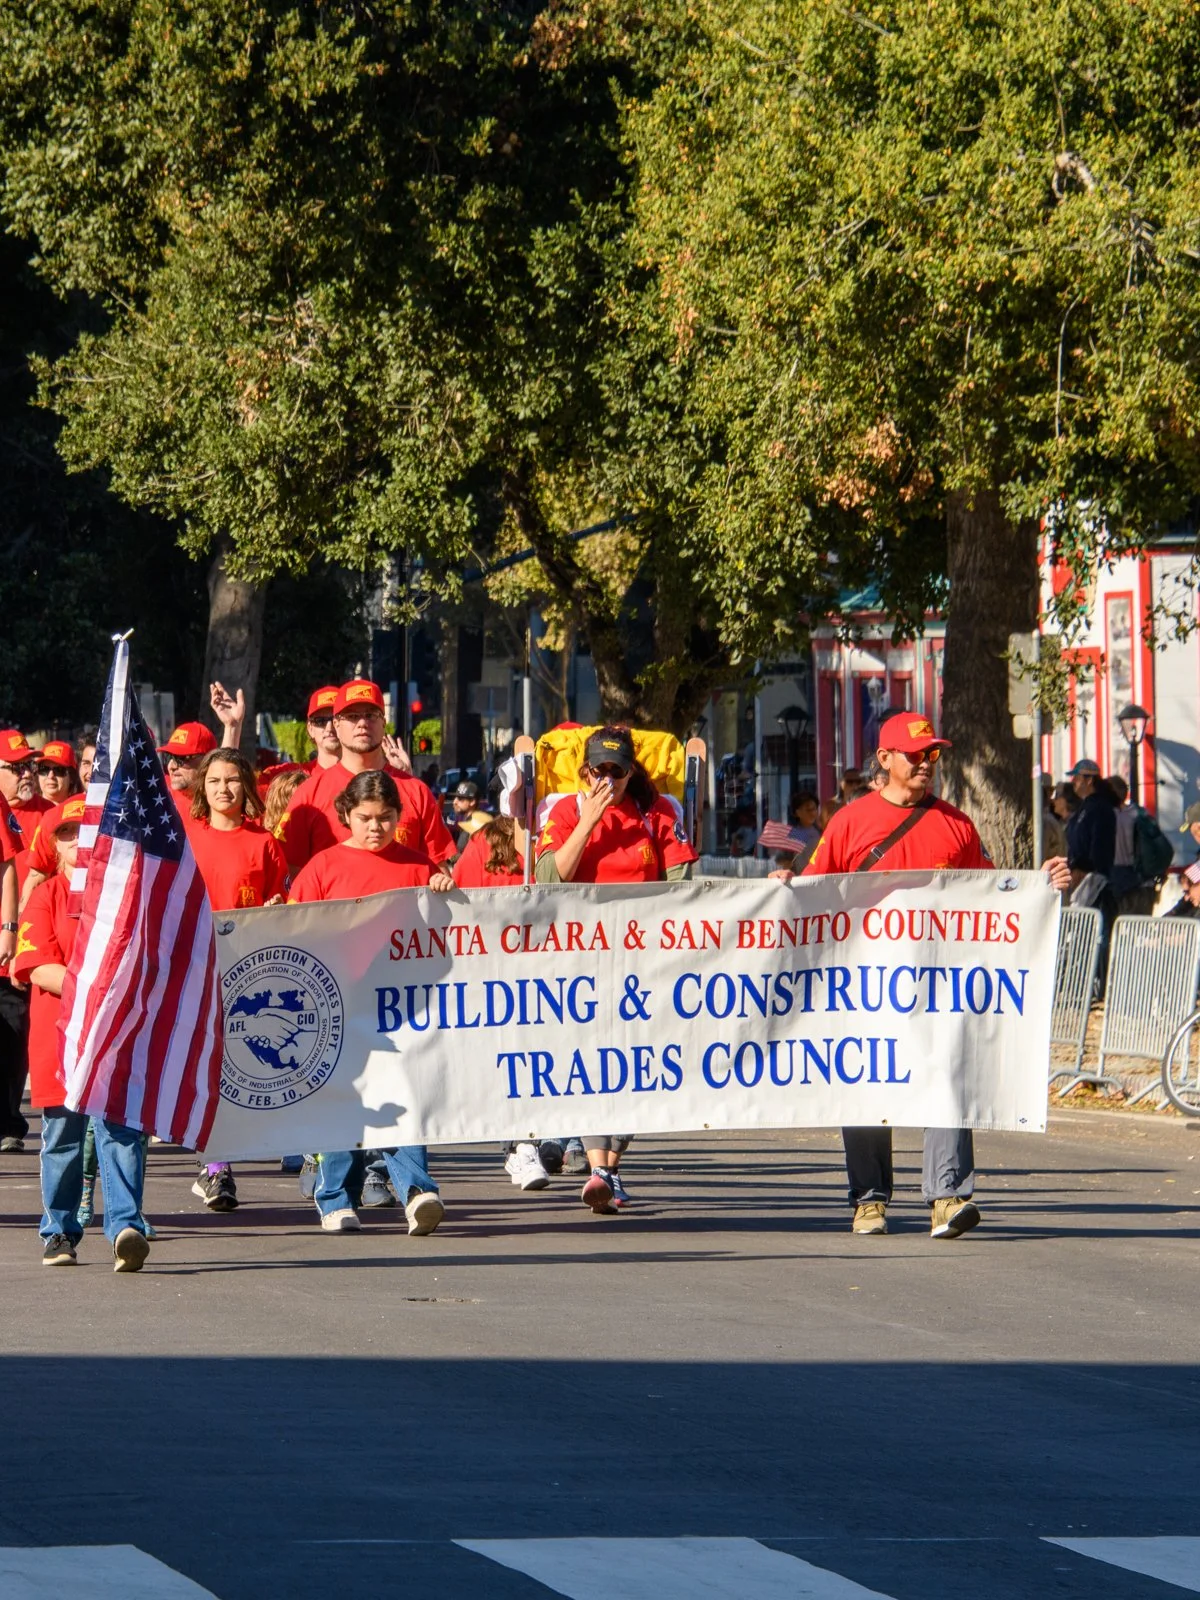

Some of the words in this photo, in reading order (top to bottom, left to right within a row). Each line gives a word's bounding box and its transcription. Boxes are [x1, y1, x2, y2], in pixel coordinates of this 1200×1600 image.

[388, 924, 489, 961] SANTA
[500, 920, 611, 953] CLARA
[623, 919, 647, 951] &
[660, 918, 725, 951] SAN
[736, 911, 851, 950] BENITO
[862, 908, 1021, 944] COUNTIES
[223, 949, 309, 989] CONSTRUCTION
[310, 962, 340, 1009] TRADES
[326, 1015, 341, 1052] DEPT.
[244, 966, 289, 984] FEDERATION
[291, 969, 303, 978] OF
[302, 976, 322, 1000] LABOR
[375, 975, 599, 1034] BUILDING
[618, 973, 652, 1021] &
[672, 965, 1030, 1019] CONSTRUCTION
[228, 1021, 247, 1034] AFL
[297, 1013, 315, 1026] CIO
[237, 1076, 247, 1085] OF
[249, 1076, 295, 1089] INDUSTRIAL
[296, 1018, 328, 1079] ORGANIZATIONS
[496, 1043, 684, 1099] TRADES
[702, 1036, 912, 1090] COUNCIL
[248, 1095, 276, 1107] FEB.
[305, 1060, 331, 1090] 1908
